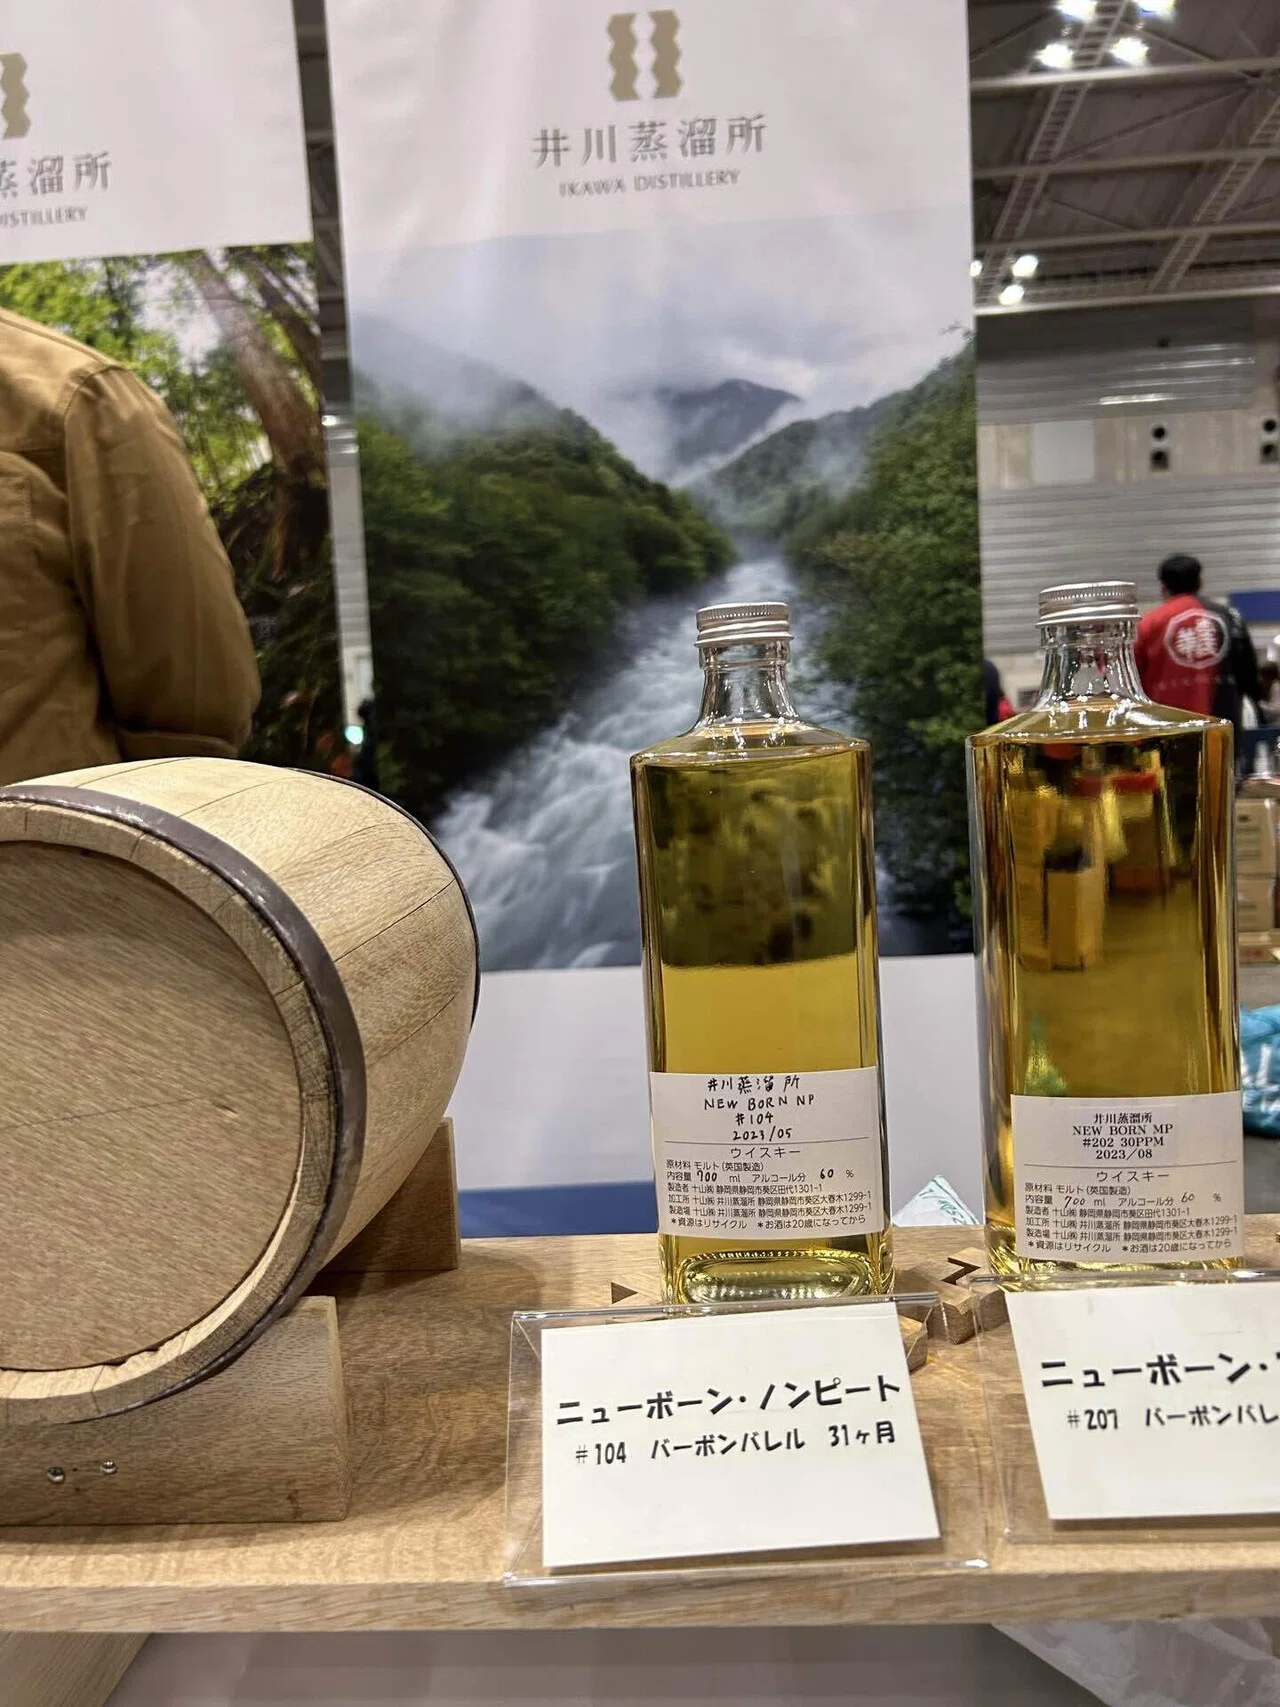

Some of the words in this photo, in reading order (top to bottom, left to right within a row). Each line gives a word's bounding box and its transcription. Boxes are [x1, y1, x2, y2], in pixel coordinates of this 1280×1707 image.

[533, 114, 766, 168] 井川蒸溜所
[559, 178, 626, 197] IKAWA
[633, 169, 741, 192] DISTILLERY
[704, 1098, 738, 1110] NEW
[747, 1096, 788, 1111] BORN
[796, 1094, 814, 1105] NP
[735, 1111, 773, 1126] #104
[1094, 1112, 1153, 1124] 井川蒸溜所
[733, 1126, 792, 1142] 2023/05
[1072, 1125, 1103, 1136] NEW
[1110, 1125, 1147, 1135] BORN
[1153, 1123, 1174, 1134] MP
[1082, 1137, 1114, 1148] #202
[1120, 1136, 1165, 1147] 30PPM
[730, 1147, 801, 1159] ウイスキー
[1096, 1148, 1153, 1160] 2023/08
[666, 1159, 691, 1169] 原材料
[667, 1171, 692, 1181] 内容量
[696, 1170, 718, 1182] 700
[729, 1174, 740, 1183] ml
[752, 1172, 806, 1183] アルコール分
[820, 1168, 834, 1179] 60
[845, 1169, 854, 1178] %
[1096, 1170, 1170, 1182] ウイスキー
[667, 1182, 689, 1192] 製造者
[1025, 1182, 1053, 1193] 原材料
[668, 1194, 690, 1204] 加工所
[1025, 1194, 1053, 1204] 内容量
[1064, 1195, 1086, 1208] 700
[1094, 1198, 1106, 1206] ml
[1118, 1196, 1174, 1207] アルコール分
[1181, 1191, 1195, 1203] 60
[1213, 1193, 1222, 1202] %
[1025, 1205, 1049, 1216] 製造者
[1026, 1217, 1049, 1227] 加工所
[1041, 1353, 1280, 1388] ニューボーン・
[557, 1375, 900, 1425] ニューボーン・ノンピート
[575, 1442, 627, 1465] #104
[650, 1428, 805, 1460] バーボンバレル
